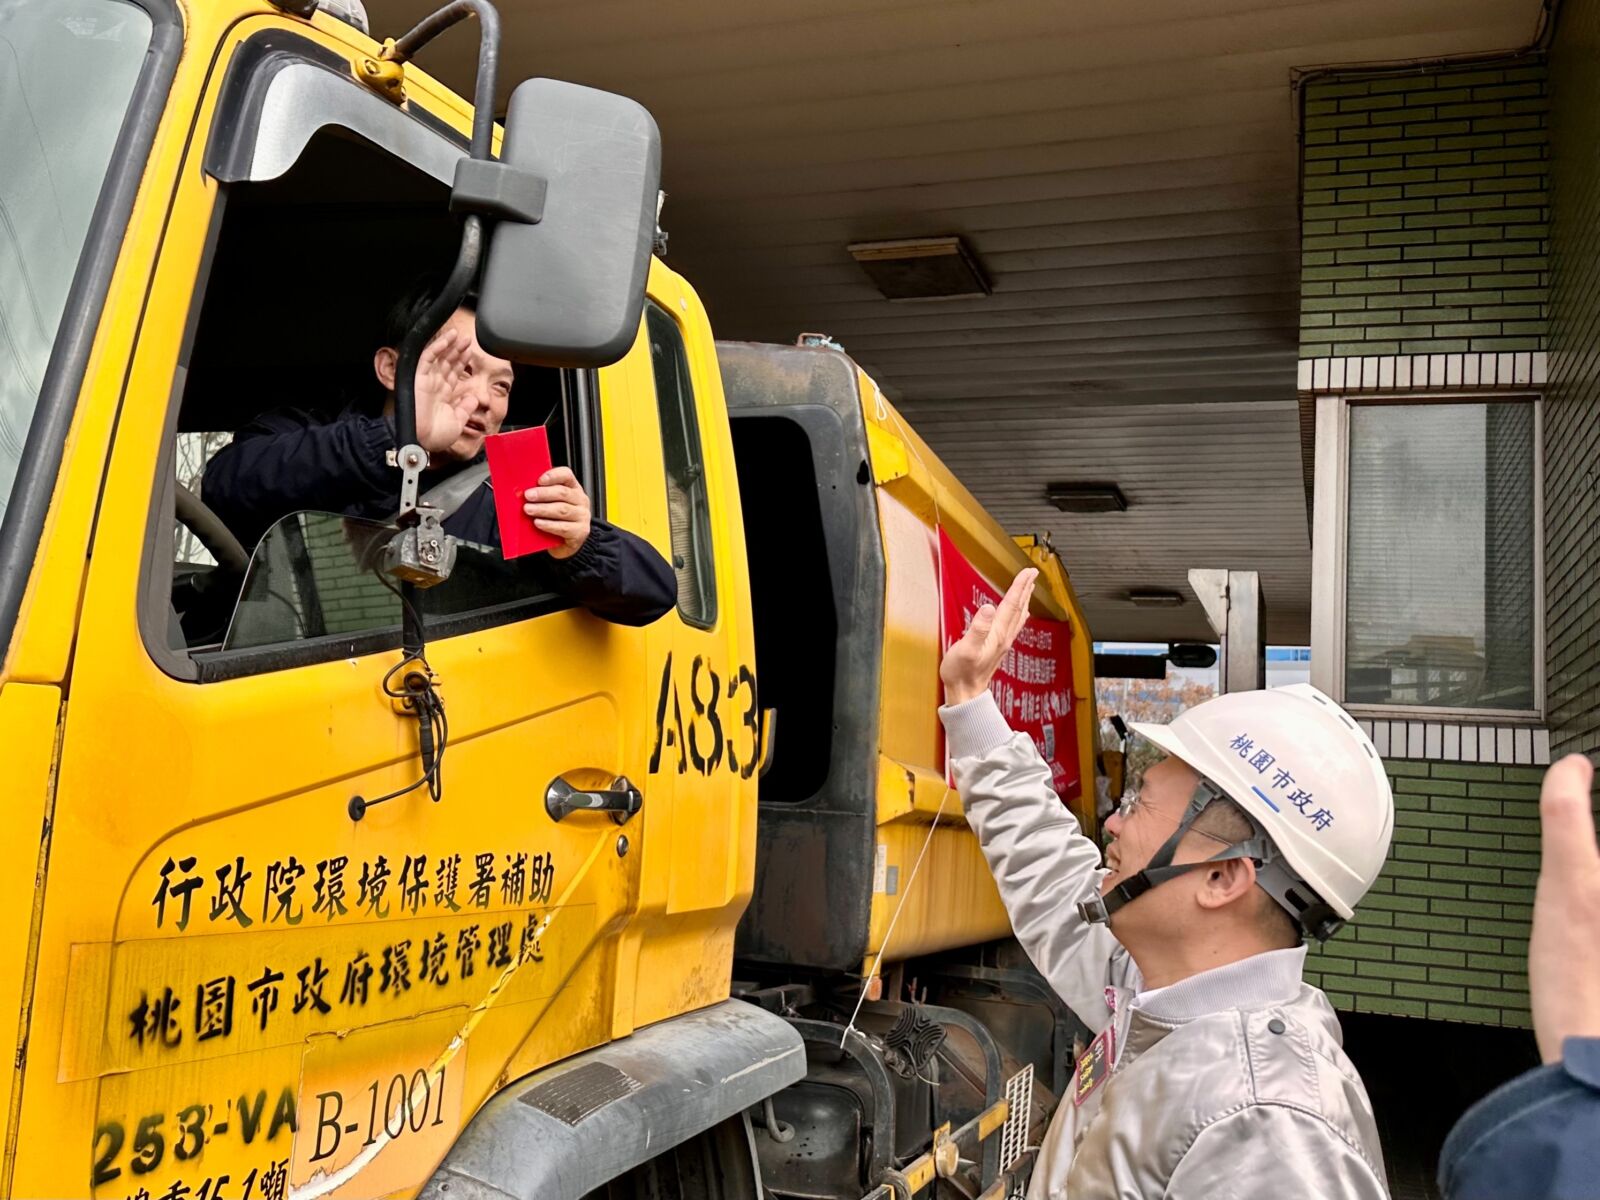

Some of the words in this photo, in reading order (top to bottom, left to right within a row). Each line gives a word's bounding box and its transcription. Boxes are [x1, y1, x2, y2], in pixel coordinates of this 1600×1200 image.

[648, 650, 758, 780] A83
[1229, 733, 1335, 832] 桃園市政府
[152, 852, 554, 932] 行政院環境保護署補助
[129, 914, 543, 1048] 桃園市政府環境管理處
[309, 1064, 446, 1162] B-1001
